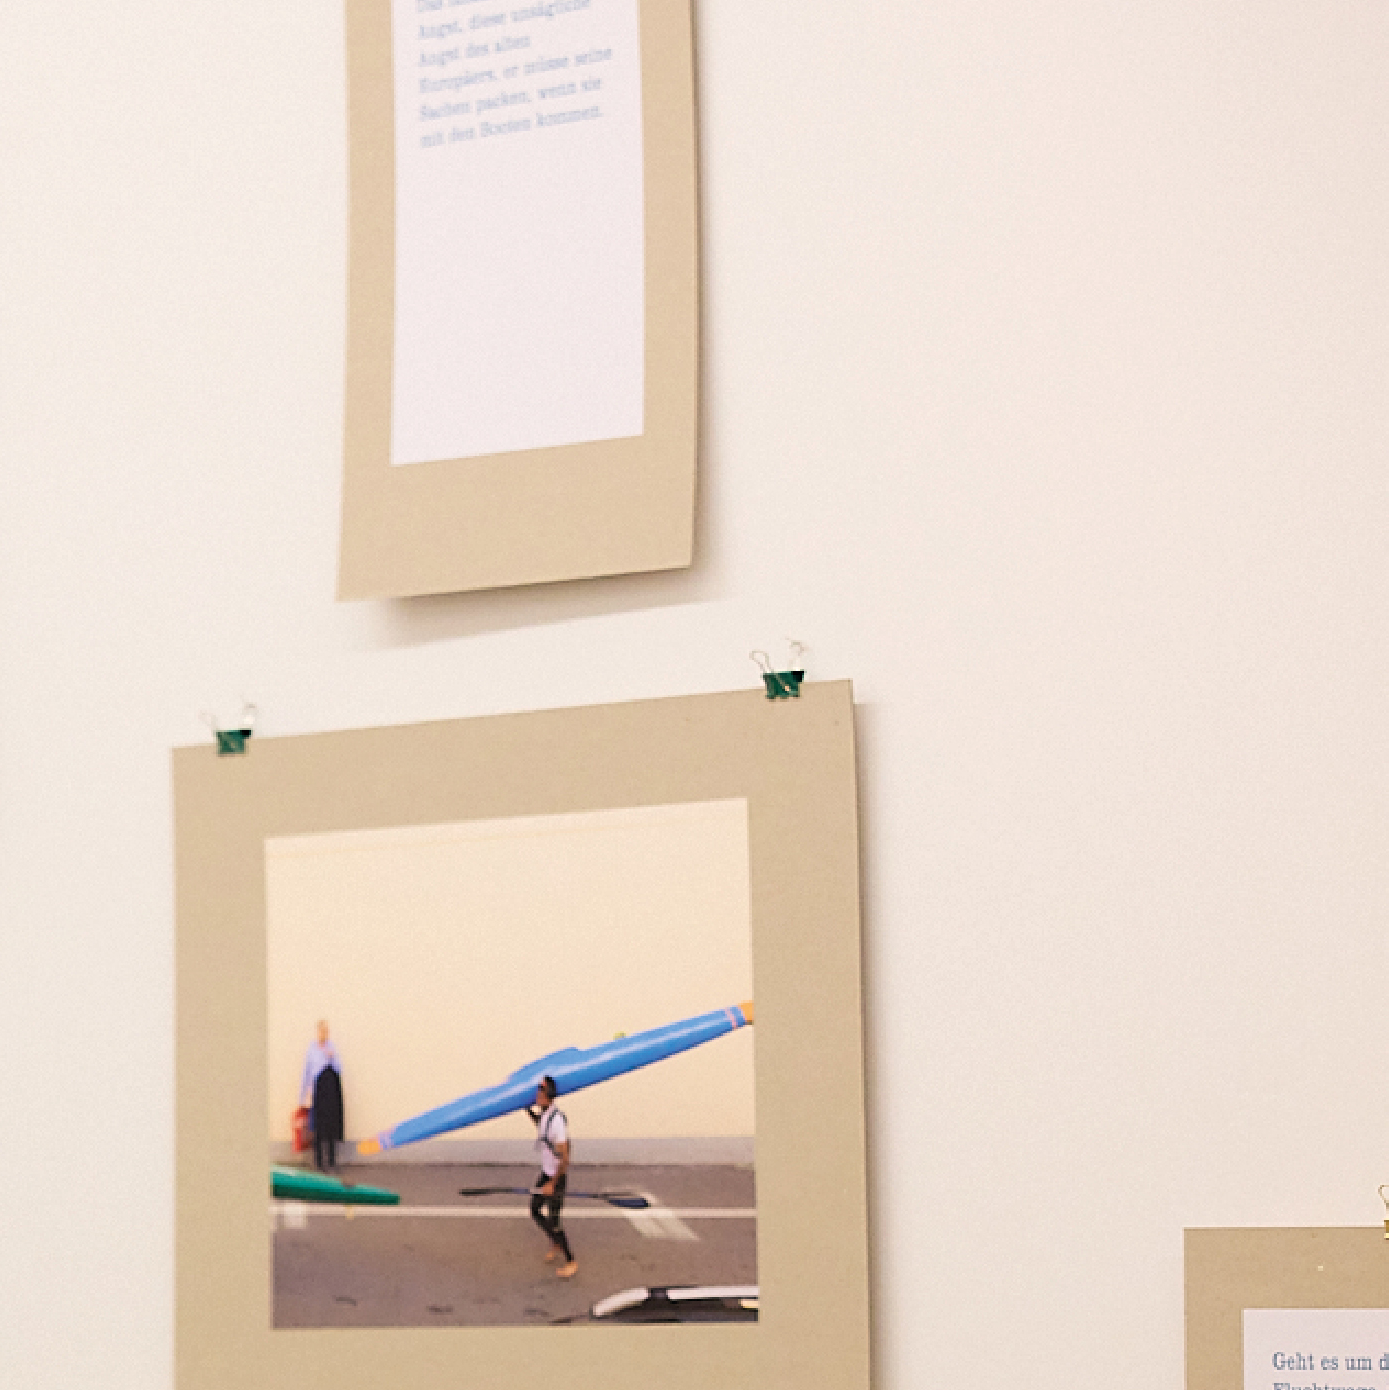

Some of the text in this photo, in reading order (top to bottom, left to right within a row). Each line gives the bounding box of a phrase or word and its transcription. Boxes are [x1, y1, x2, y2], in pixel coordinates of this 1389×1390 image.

[1272, 1352, 1314, 1370] Geht
[1321, 1356, 1339, 1370] es
[1345, 1356, 1373, 1370] um
